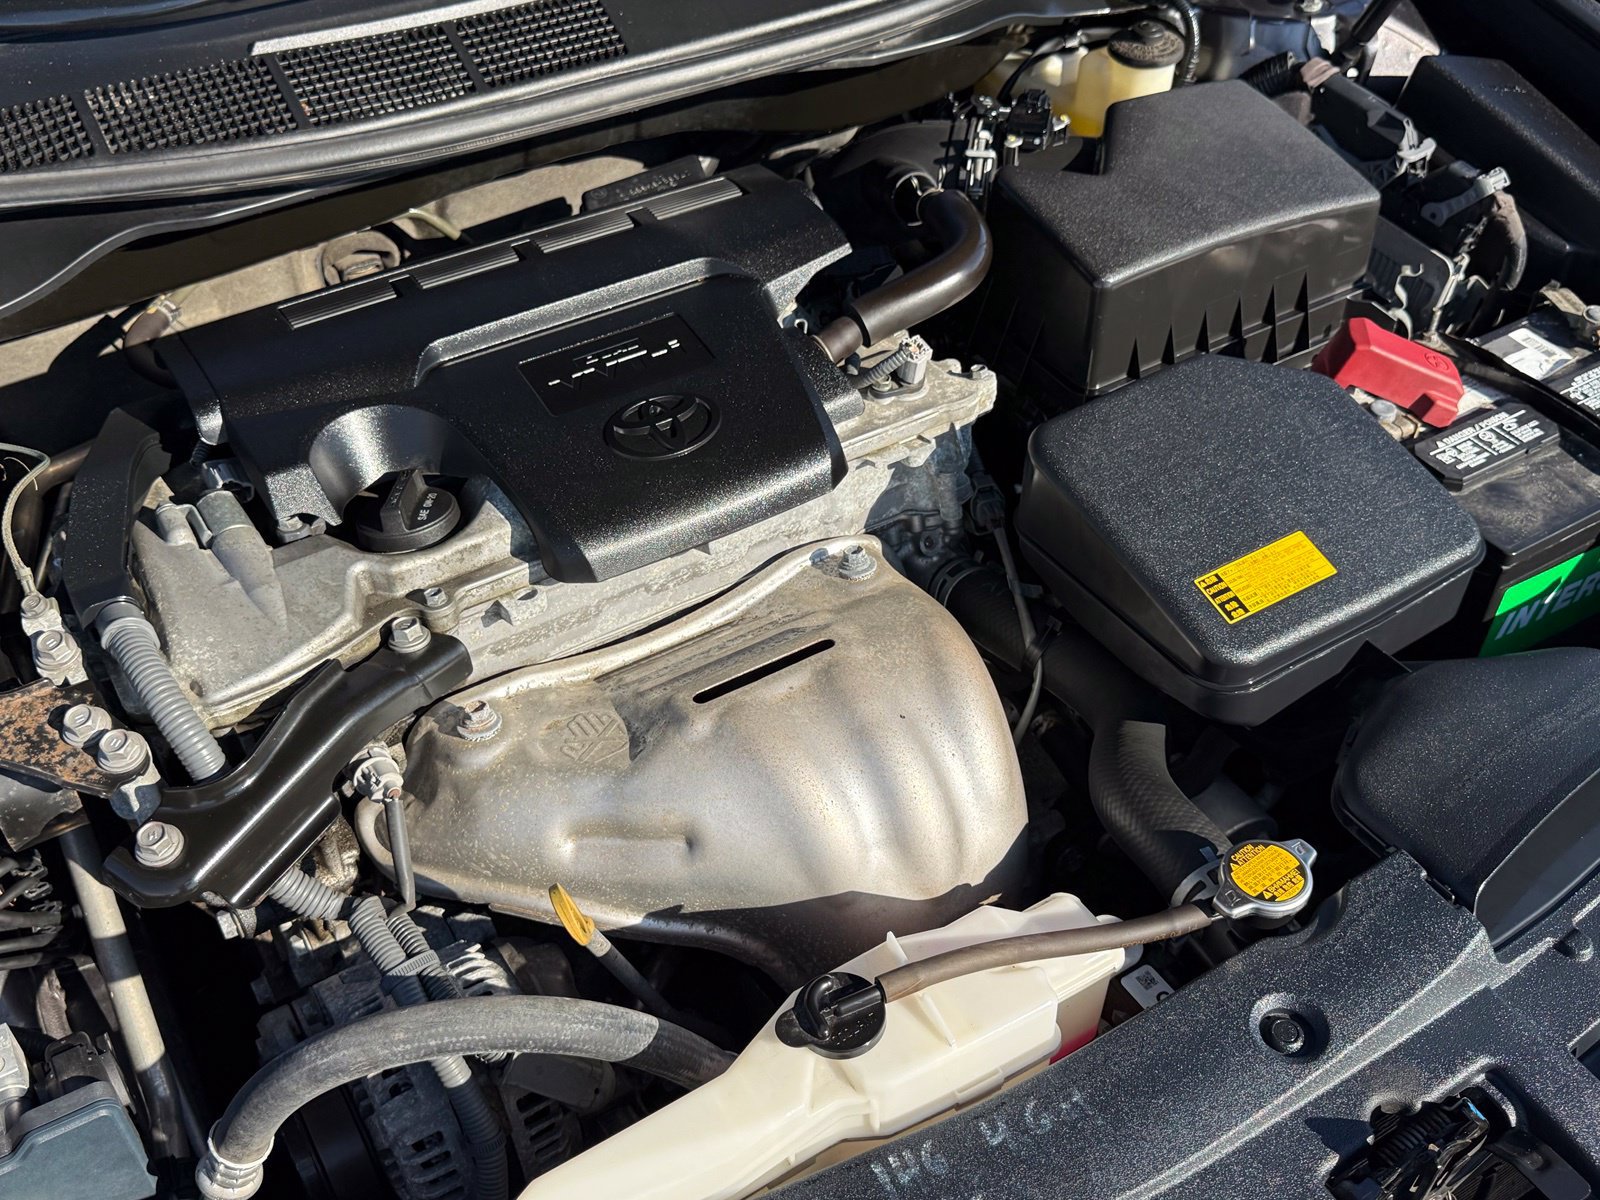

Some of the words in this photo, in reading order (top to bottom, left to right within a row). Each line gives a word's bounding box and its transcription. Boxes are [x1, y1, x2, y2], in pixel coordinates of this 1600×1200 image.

[417, 508, 430, 521] SAE
[1494, 571, 1600, 641] INTER
[1230, 843, 1255, 861] CAUTION
[1236, 844, 1266, 866] ATTENTION
